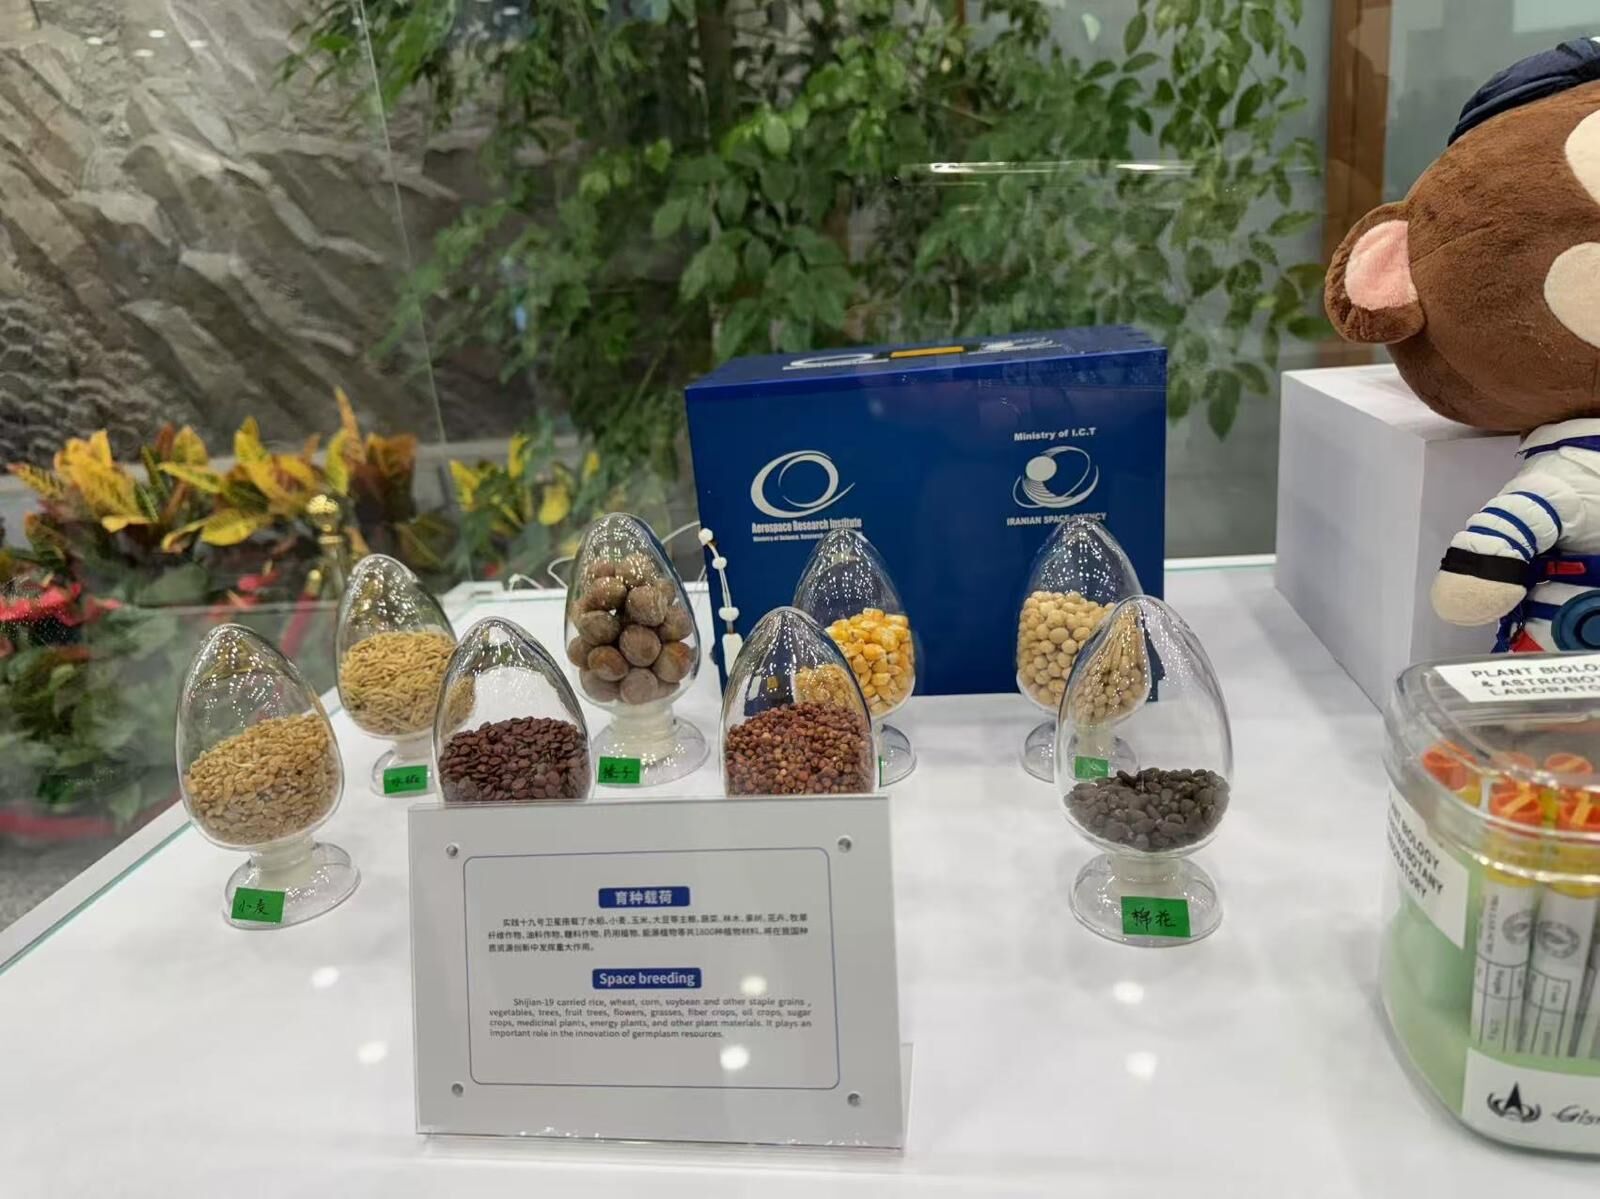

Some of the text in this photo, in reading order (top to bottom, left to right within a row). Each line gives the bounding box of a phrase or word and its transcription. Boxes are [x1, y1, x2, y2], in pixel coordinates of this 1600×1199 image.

[1014, 427, 1096, 441] Ministry of I.C.T
[1007, 516, 1042, 526] IRANIAN
[752, 522, 792, 534] Aerospace
[1471, 663, 1600, 678] PLANT BIOLO
[614, 890, 673, 905] 育种载荷
[1131, 906, 1177, 932] 棉花
[599, 972, 696, 987] Space breeding
[514, 998, 554, 1008] Shijian-19
[557, 998, 586, 1007] carried
[589, 998, 607, 1008] rice,
[610, 998, 638, 1008] wheat,
[641, 999, 663, 1008] corn,
[665, 998, 701, 1009] soybean
[703, 998, 721, 1006] and
[723, 998, 746, 1006] other
[749, 998, 776, 1008] staple
[489, 1009, 535, 1018] vegetables,
[538, 1009, 562, 1017] trees,
[586, 1009, 610, 1017] trees,
[613, 1009, 647, 1017] flowers,
[650, 1010, 684, 1018] grasses,
[688, 1009, 707, 1017] fiber
[711, 1010, 738, 1018] crops,
[742, 1009, 753, 1017] oil
[787, 1010, 812, 1018] sugar
[489, 1020, 515, 1028] crops,
[516, 1019, 557, 1027] medicinal
[559, 1019, 588, 1028] plants,
[590, 1020, 618, 1029] energy
[621, 1019, 649, 1028] plants,
[652, 1019, 668, 1027] and
[670, 1019, 693, 1027] other
[695, 1019, 718, 1028] plant
[721, 1019, 762, 1027] materials.
[766, 1019, 773, 1027] It
[775, 1019, 798, 1029] plays
[490, 1029, 724, 1040] important role in the innovation of germplasm resources.
